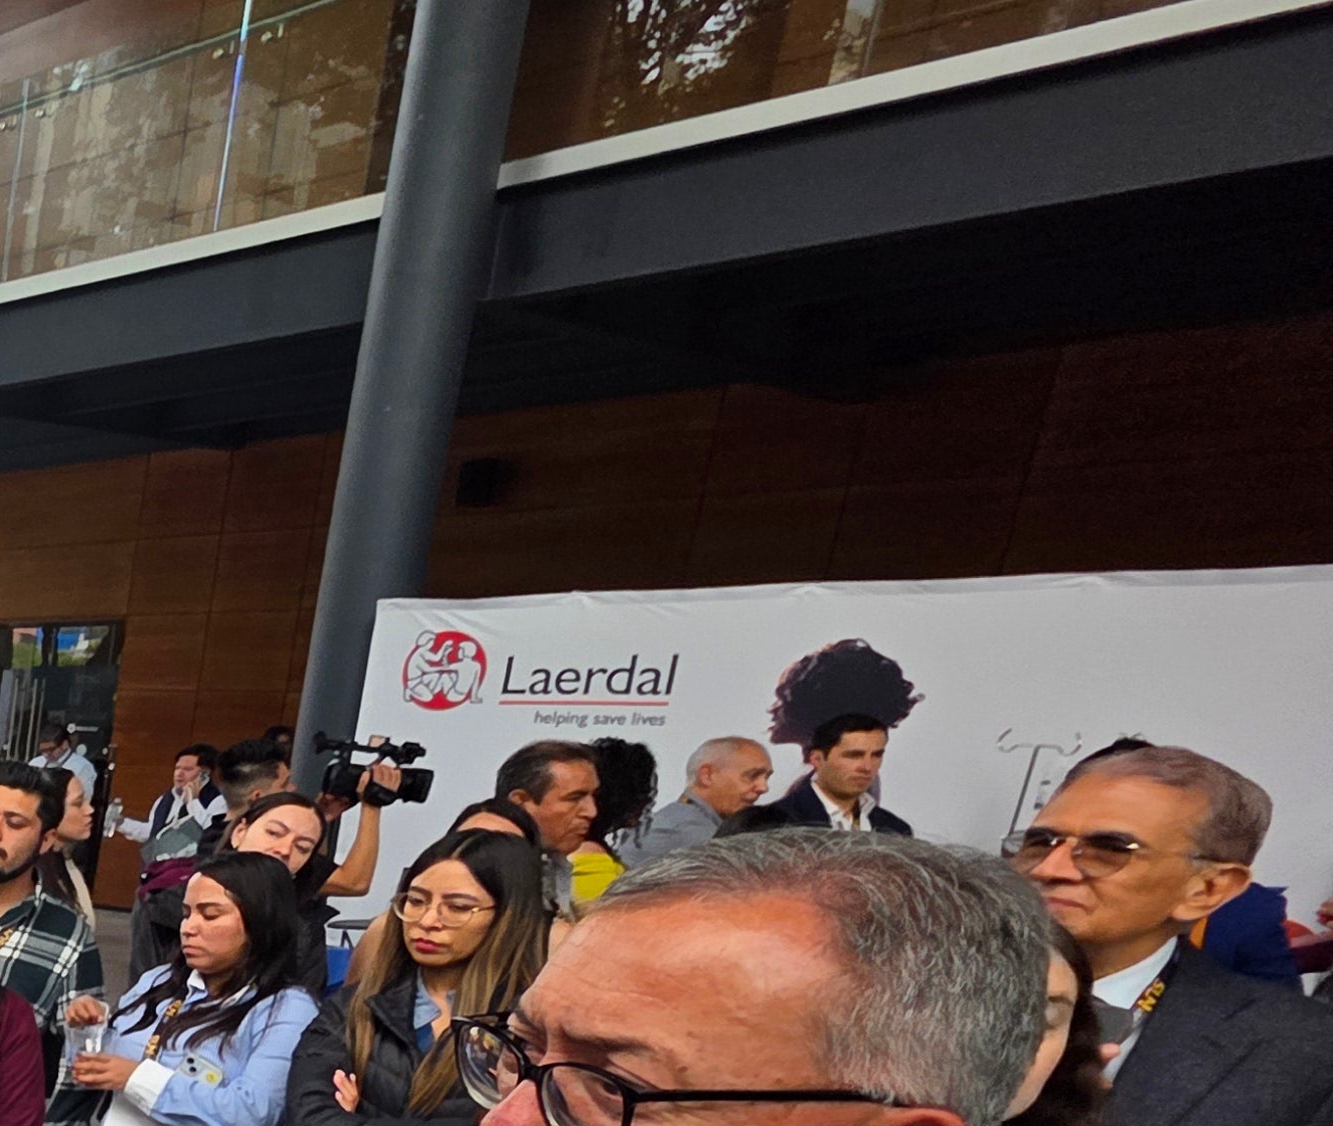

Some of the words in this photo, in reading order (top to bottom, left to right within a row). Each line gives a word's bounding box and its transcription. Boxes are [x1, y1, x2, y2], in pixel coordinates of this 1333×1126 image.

[501, 653, 679, 696] Laerdal
[533, 710, 589, 728] helping
[592, 713, 627, 727] save
[630, 711, 667, 727] lives
